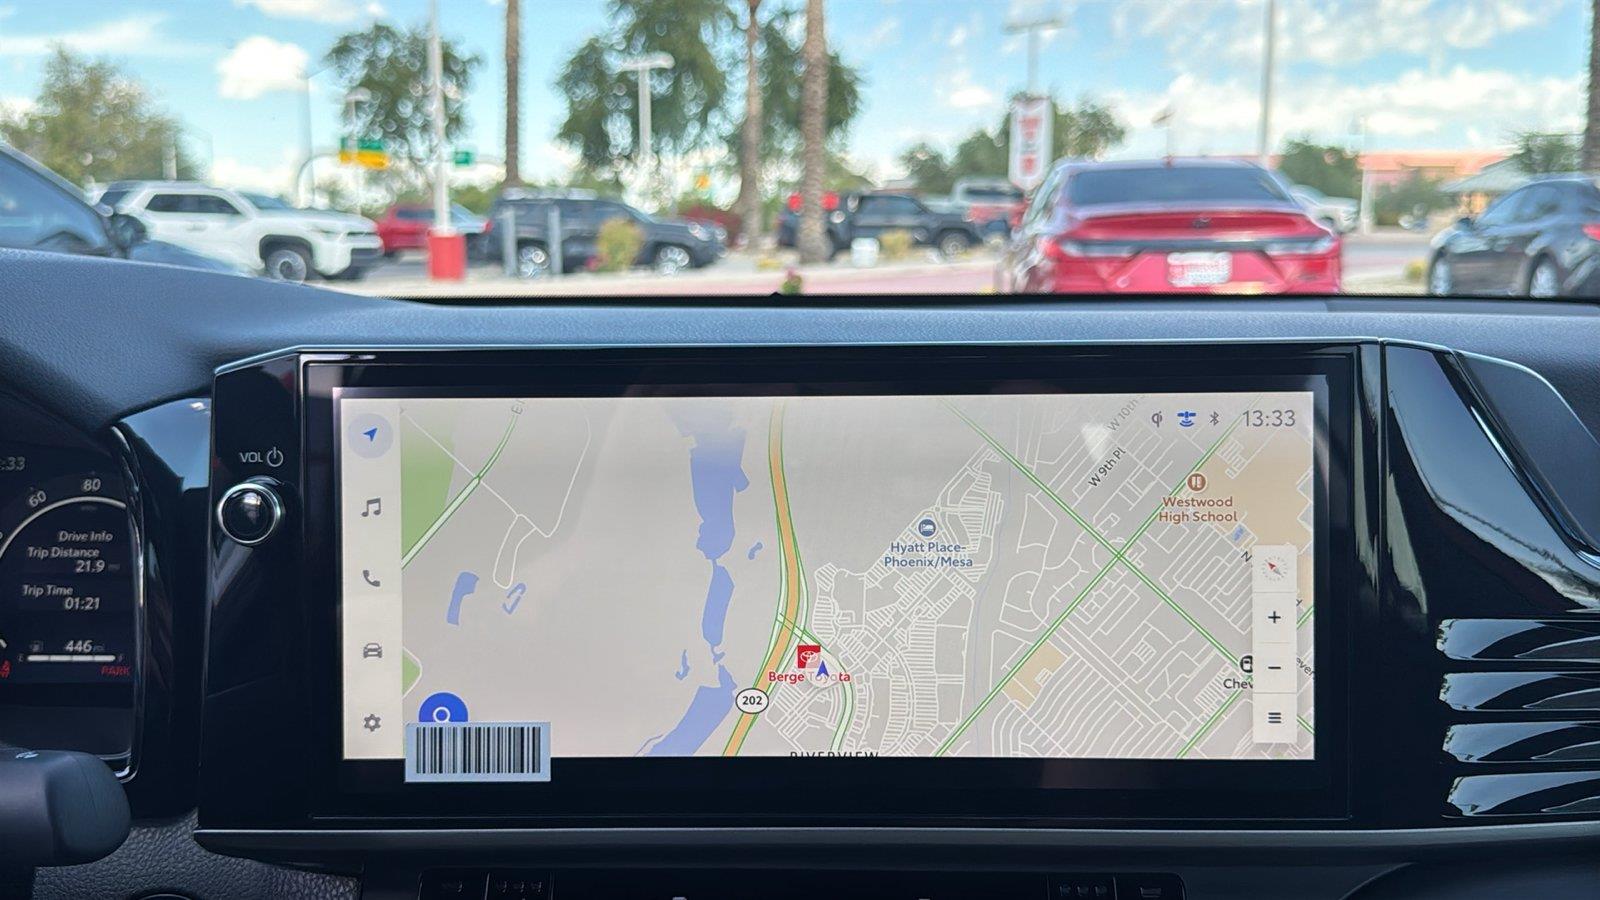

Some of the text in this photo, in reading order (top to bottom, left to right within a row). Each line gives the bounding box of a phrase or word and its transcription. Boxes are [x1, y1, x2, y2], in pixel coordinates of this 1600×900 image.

[1107, 418, 1120, 431] W
[1242, 410, 1296, 427] 13:33
[239, 451, 263, 463] VOL
[1088, 447, 1126, 486] W 9th Pl
[83, 478, 101, 492] 80
[28, 490, 47, 508] 60
[1162, 496, 1233, 507] Westwood
[1158, 511, 1238, 525] High School
[58, 531, 114, 542] Drive Info
[27, 546, 100, 560] Trip Distance
[890, 541, 967, 555] Hyatt Place-
[75, 559, 106, 573] 21.9
[884, 556, 973, 568] Phoenix/Mesa
[22, 584, 74, 598] Trip Time
[64, 596, 101, 611] 01:21
[64, 640, 94, 653] 446
[768, 671, 851, 685] Berge Toyota
[742, 695, 763, 706] 202
